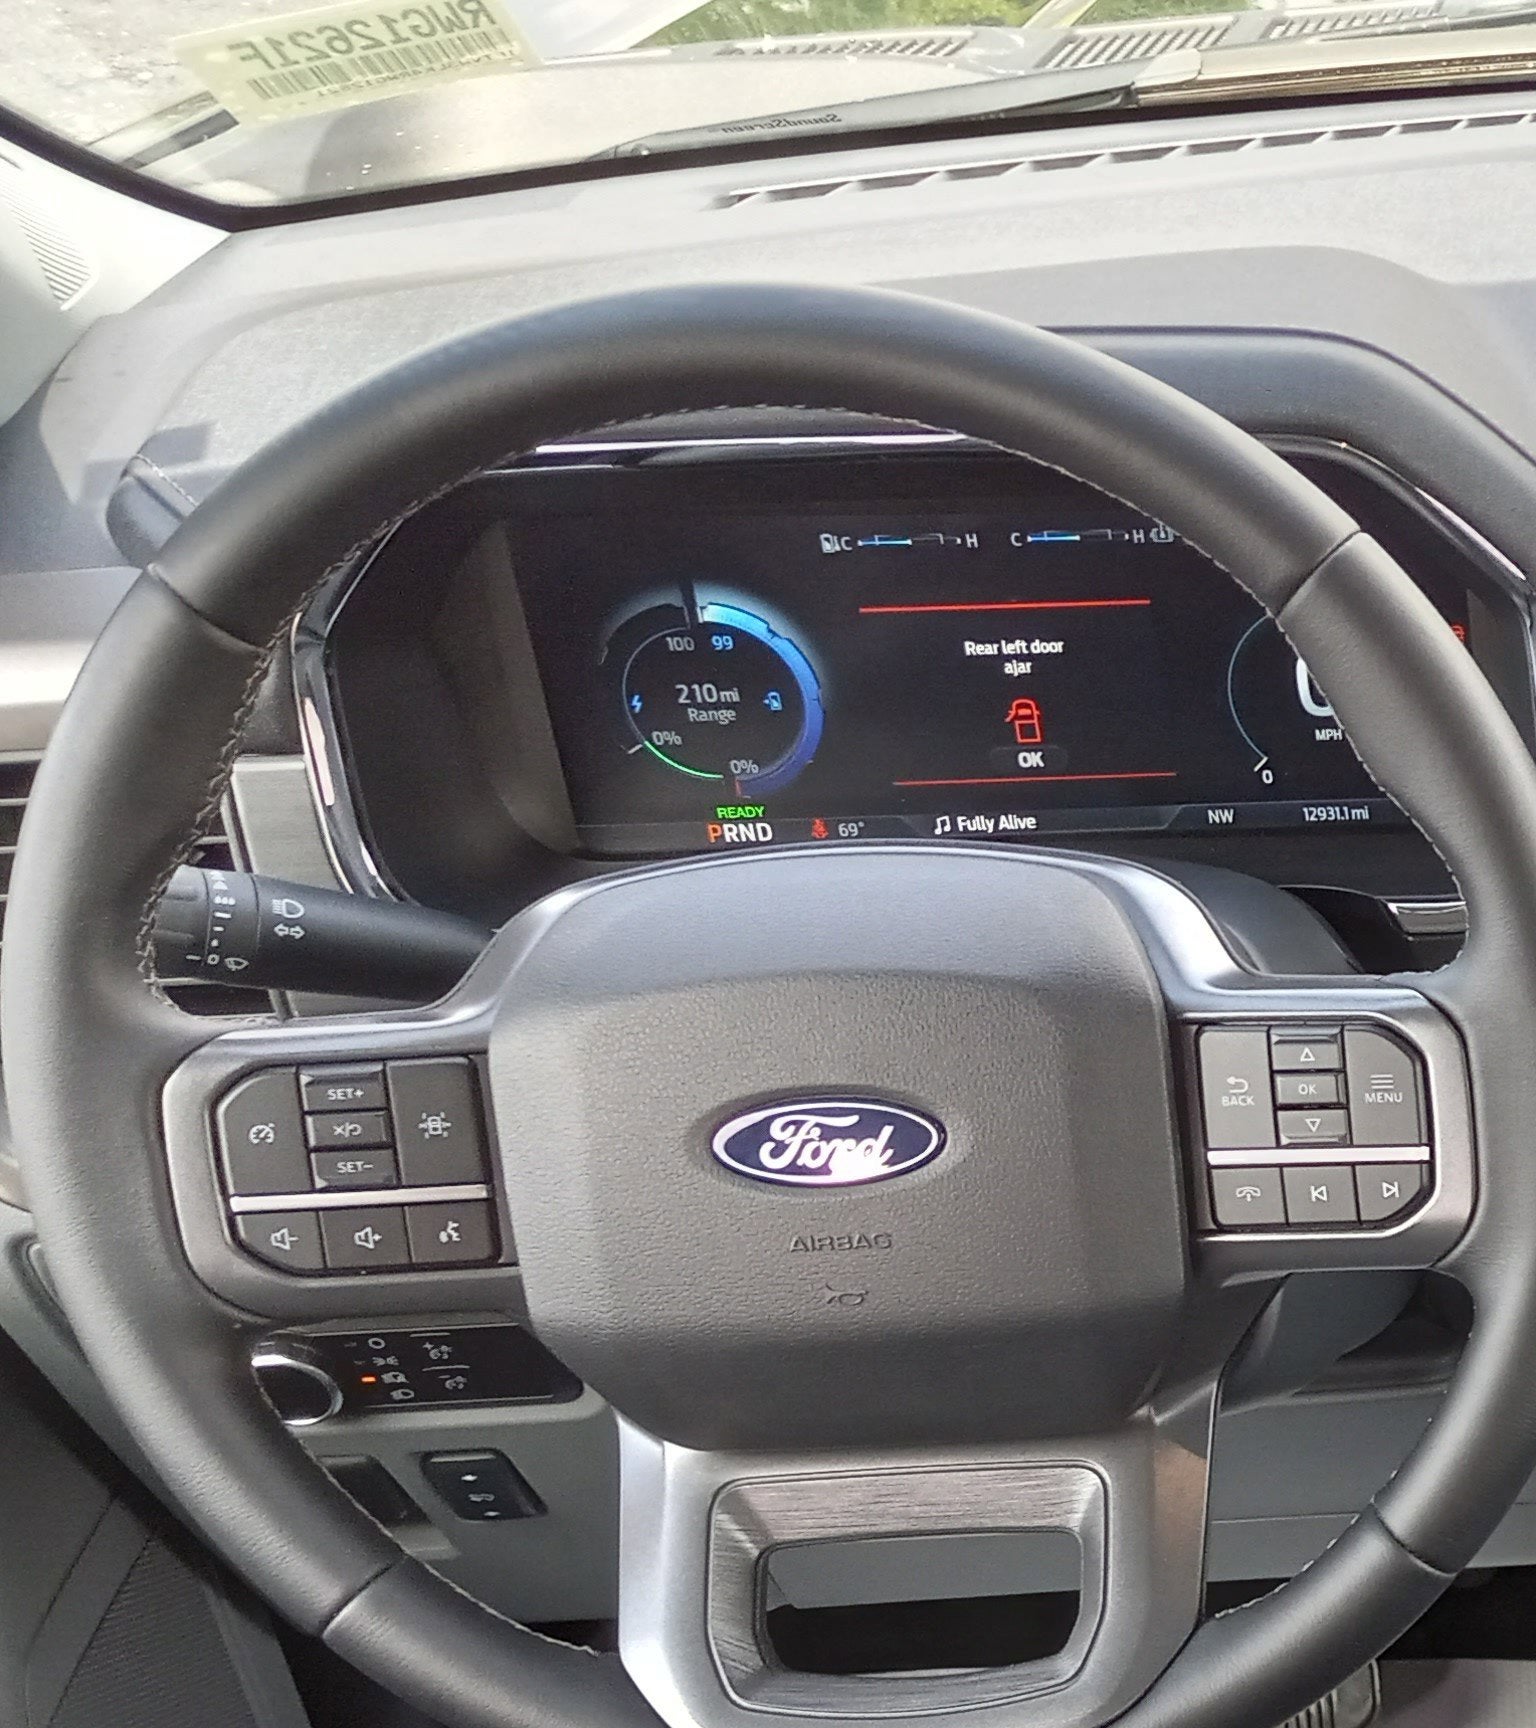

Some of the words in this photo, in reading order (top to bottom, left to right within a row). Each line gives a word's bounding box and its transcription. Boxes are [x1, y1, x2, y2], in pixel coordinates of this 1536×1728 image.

[966, 534, 979, 549] H
[1010, 532, 1023, 547] C
[1133, 529, 1145, 544] H
[666, 636, 695, 651] 100
[711, 635, 734, 650] 99
[964, 640, 999, 656] Rear
[1002, 638, 1027, 655] left
[1031, 637, 1064, 654] door
[1004, 658, 1032, 677] ajar
[675, 683, 718, 704] 210
[688, 707, 737, 725] Range
[652, 731, 682, 745] 0%
[1315, 728, 1343, 741] MPH
[730, 759, 759, 774] 0%
[1018, 751, 1044, 768] OK
[1262, 769, 1273, 784] 0
[716, 806, 765, 819] READY
[1207, 809, 1235, 824] NW
[1303, 806, 1349, 822] 12931.1
[838, 821, 865, 837] 69°
[957, 815, 994, 833] Fully
[999, 814, 1037, 831] Alive
[707, 823, 773, 842] PRND
[1298, 1083, 1317, 1095] OK
[1222, 1095, 1255, 1107] BACK
[1364, 1092, 1403, 1103] MENU
[759, 1114, 895, 1171] Ford
[790, 1232, 893, 1253] AIRBAG
